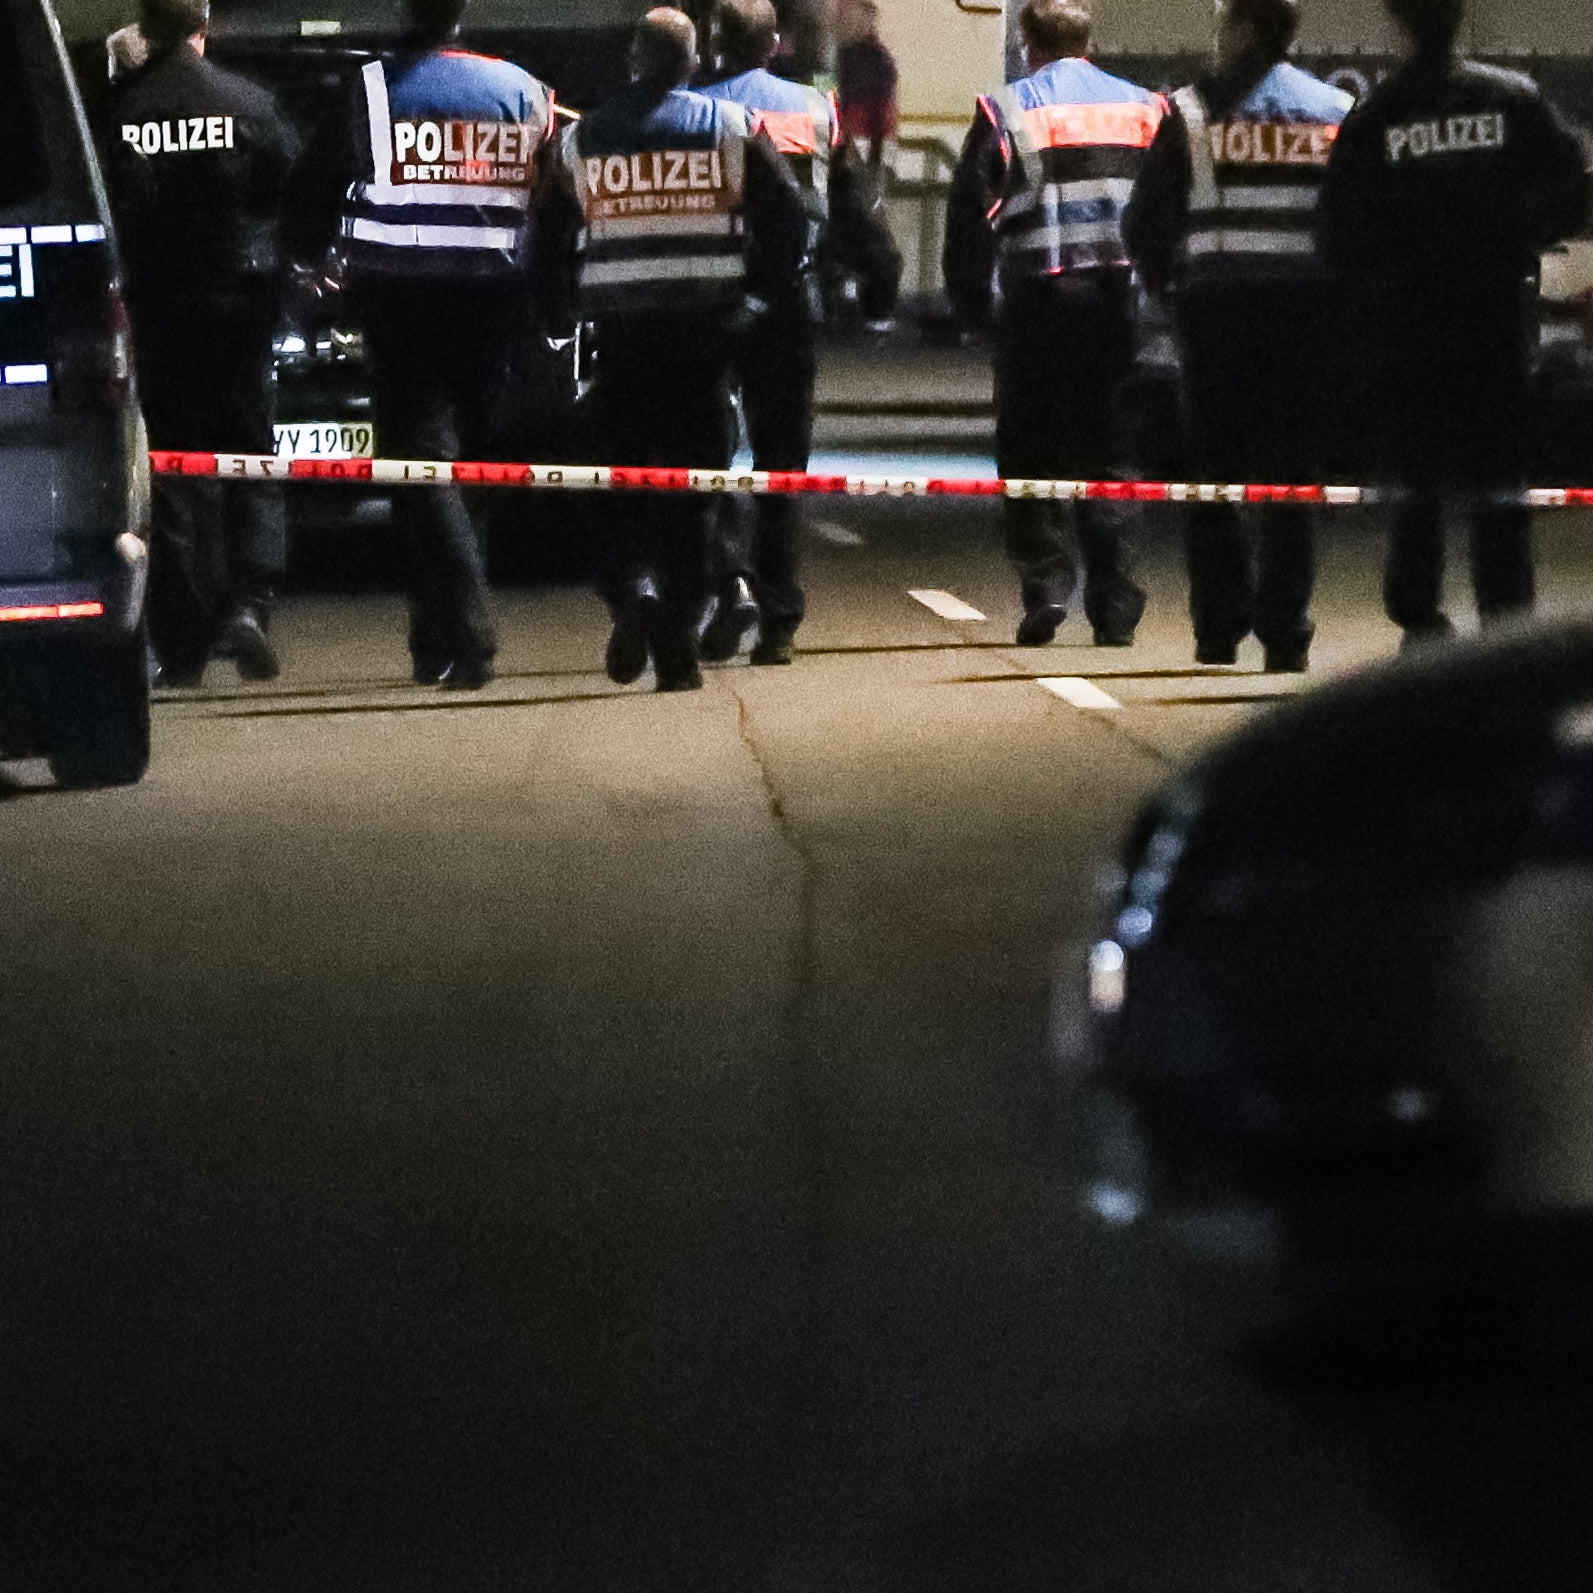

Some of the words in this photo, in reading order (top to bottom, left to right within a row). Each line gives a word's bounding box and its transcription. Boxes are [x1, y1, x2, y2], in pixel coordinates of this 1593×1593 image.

[394, 121, 529, 164] POLIZEI
[1386, 113, 1505, 161] POLIZEI
[309, 428, 370, 454] 1909
